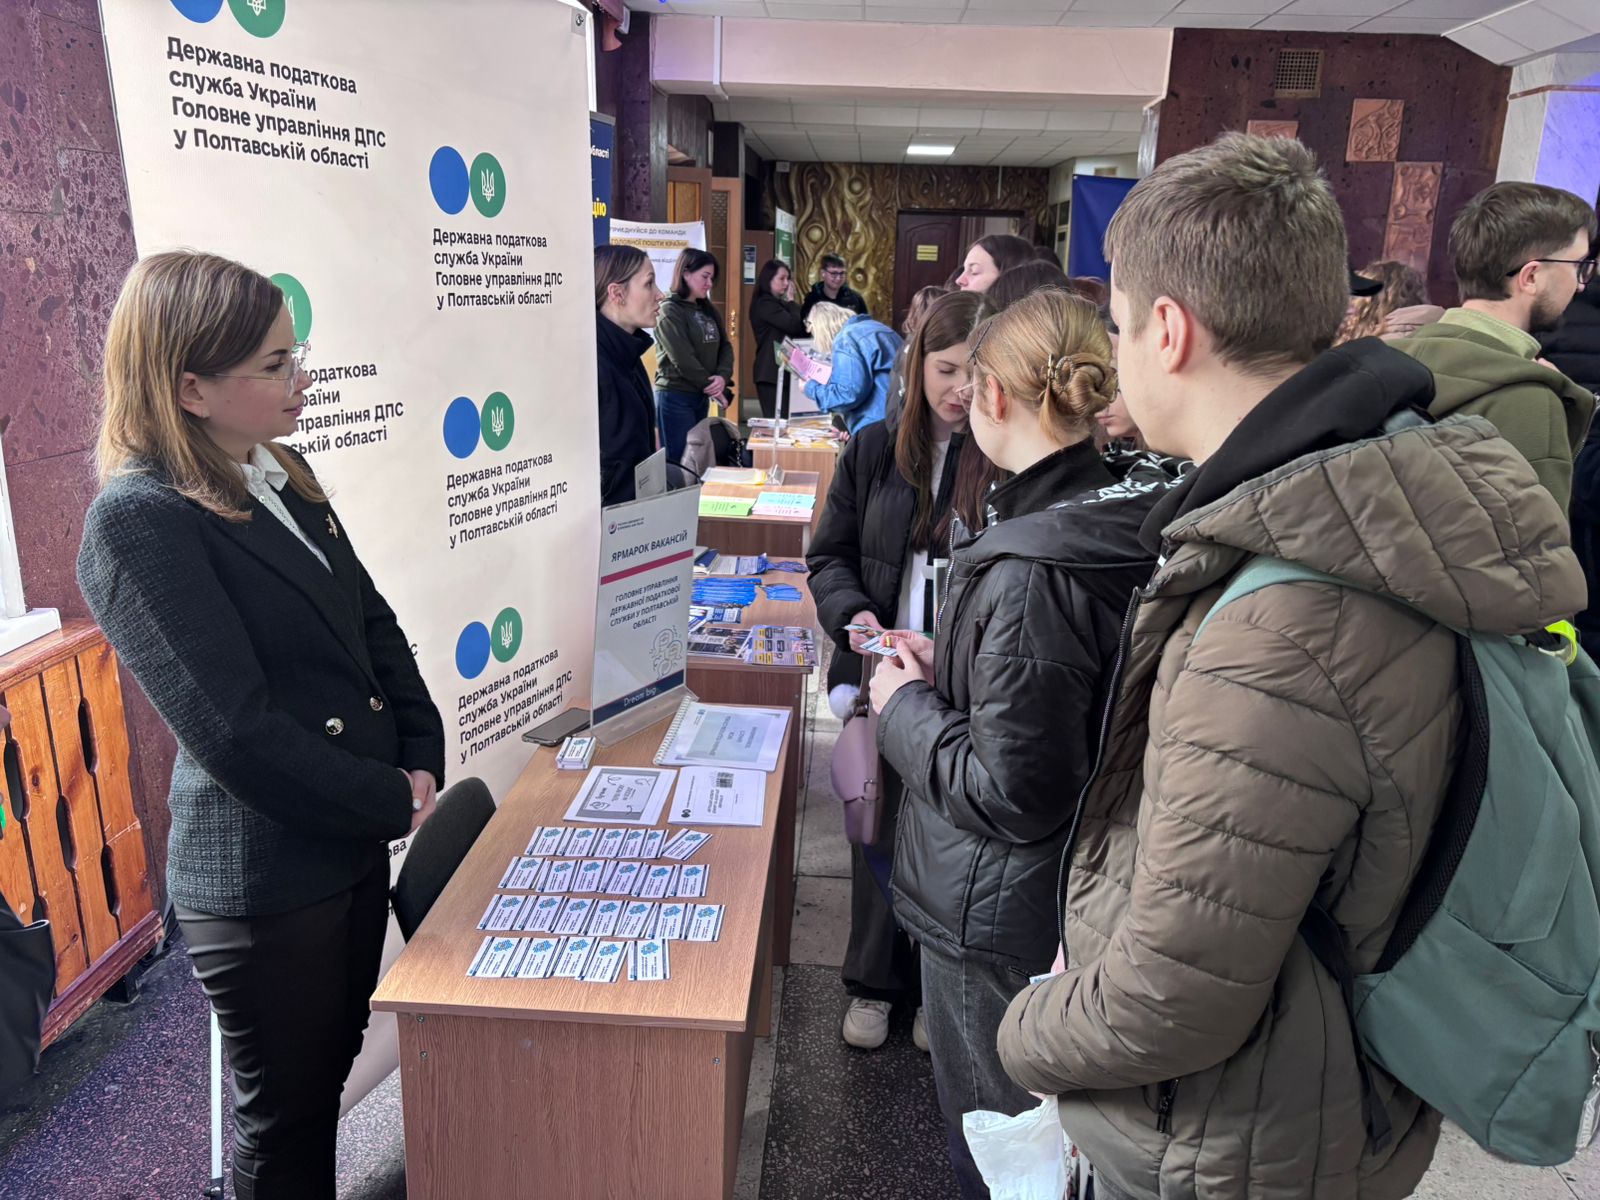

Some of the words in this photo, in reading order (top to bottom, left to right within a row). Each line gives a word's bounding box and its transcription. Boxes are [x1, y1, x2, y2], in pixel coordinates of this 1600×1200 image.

[167, 36, 265, 75] Державна
[270, 62, 357, 94] податкова
[169, 70, 244, 98] служба
[247, 81, 316, 111] України
[172, 96, 251, 126] Головне
[255, 113, 350, 142] управління
[354, 127, 386, 148] ДПС
[173, 129, 187, 150] у
[193, 128, 305, 161] Полтавській
[310, 146, 369, 169] області
[591, 145, 609, 158] бласті
[433, 228, 493, 246] Державна
[495, 234, 548, 248] податкова
[434, 250, 479, 268] служба
[481, 251, 523, 268] України
[435, 271, 482, 286] Головне
[485, 272, 542, 288] управління
[544, 272, 563, 287] ДПС
[436, 294, 444, 310] у
[447, 291, 515, 306] Полтавській
[517, 290, 552, 304] області
[305, 363, 378, 384] одаткова
[303, 388, 341, 407] раїни
[297, 409, 371, 434] правління
[374, 401, 404, 423] ДПС
[335, 425, 387, 449] області
[447, 466, 503, 491] Державна
[505, 453, 553, 474] податкова
[447, 486, 489, 508] служба
[491, 476, 531, 495] України
[449, 506, 493, 527] Головне
[495, 489, 549, 517] управління
[550, 481, 568, 499] ДПС
[449, 534, 457, 549] у
[459, 512, 524, 543] Полтавській
[525, 500, 558, 522] області
[611, 543, 650, 562] ЯРМАРОК
[650, 530, 688, 548] ВАКАНСІЙ
[610, 596, 645, 617] ДЕРЖАВНОЇ
[645, 584, 681, 603] ПОДАТКОВОЇ
[615, 587, 642, 602] ГОЛОВНЕ
[643, 575, 678, 593] УПРАВЛІННЯ
[610, 612, 635, 627] СЛУЖБИ
[640, 595, 679, 616] ПОЛТАВСЬКІЙ
[633, 615, 657, 630] ОБЛАСТІ
[458, 674, 511, 711] Державна
[513, 649, 559, 681] податкова
[458, 698, 499, 727] служба
[500, 677, 538, 704] України
[460, 713, 502, 744] Головне
[504, 683, 554, 722] управління
[555, 670, 572, 691] ДПС
[460, 750, 467, 764] у
[470, 712, 531, 756] Полтавській
[532, 692, 563, 719] області
